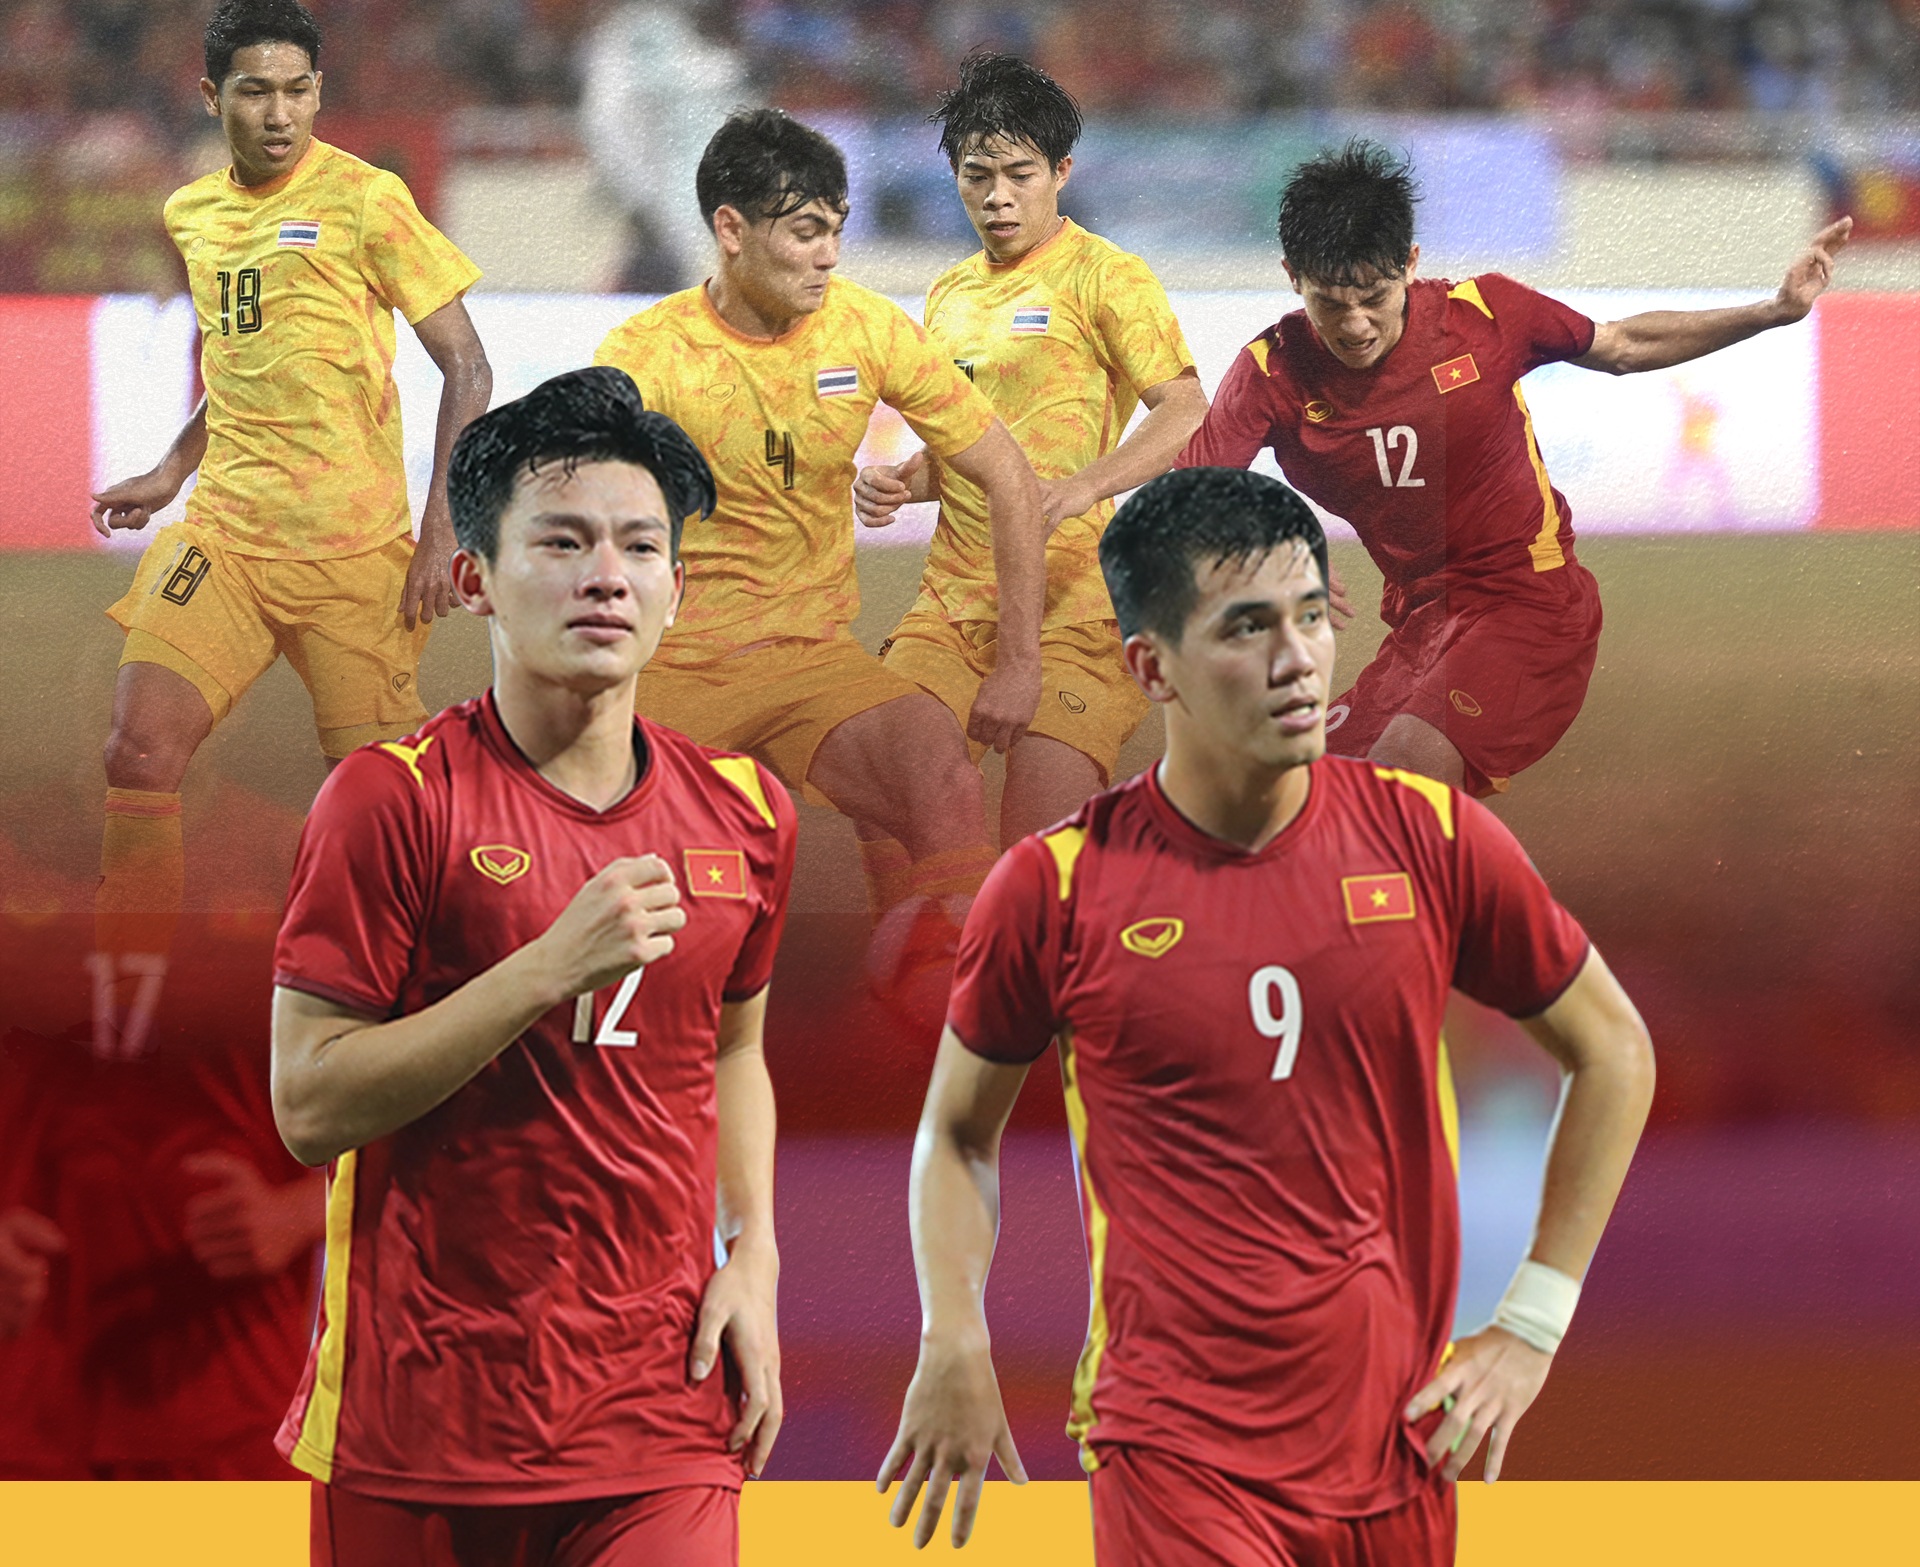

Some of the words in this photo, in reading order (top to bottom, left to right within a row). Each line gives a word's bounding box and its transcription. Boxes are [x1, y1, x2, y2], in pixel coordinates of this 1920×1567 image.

[216, 268, 262, 336] 18
[765, 429, 794, 490] 4
[1366, 425, 1426, 488] 12
[83, 953, 168, 1060] 17
[1249, 964, 1303, 1081] 9
